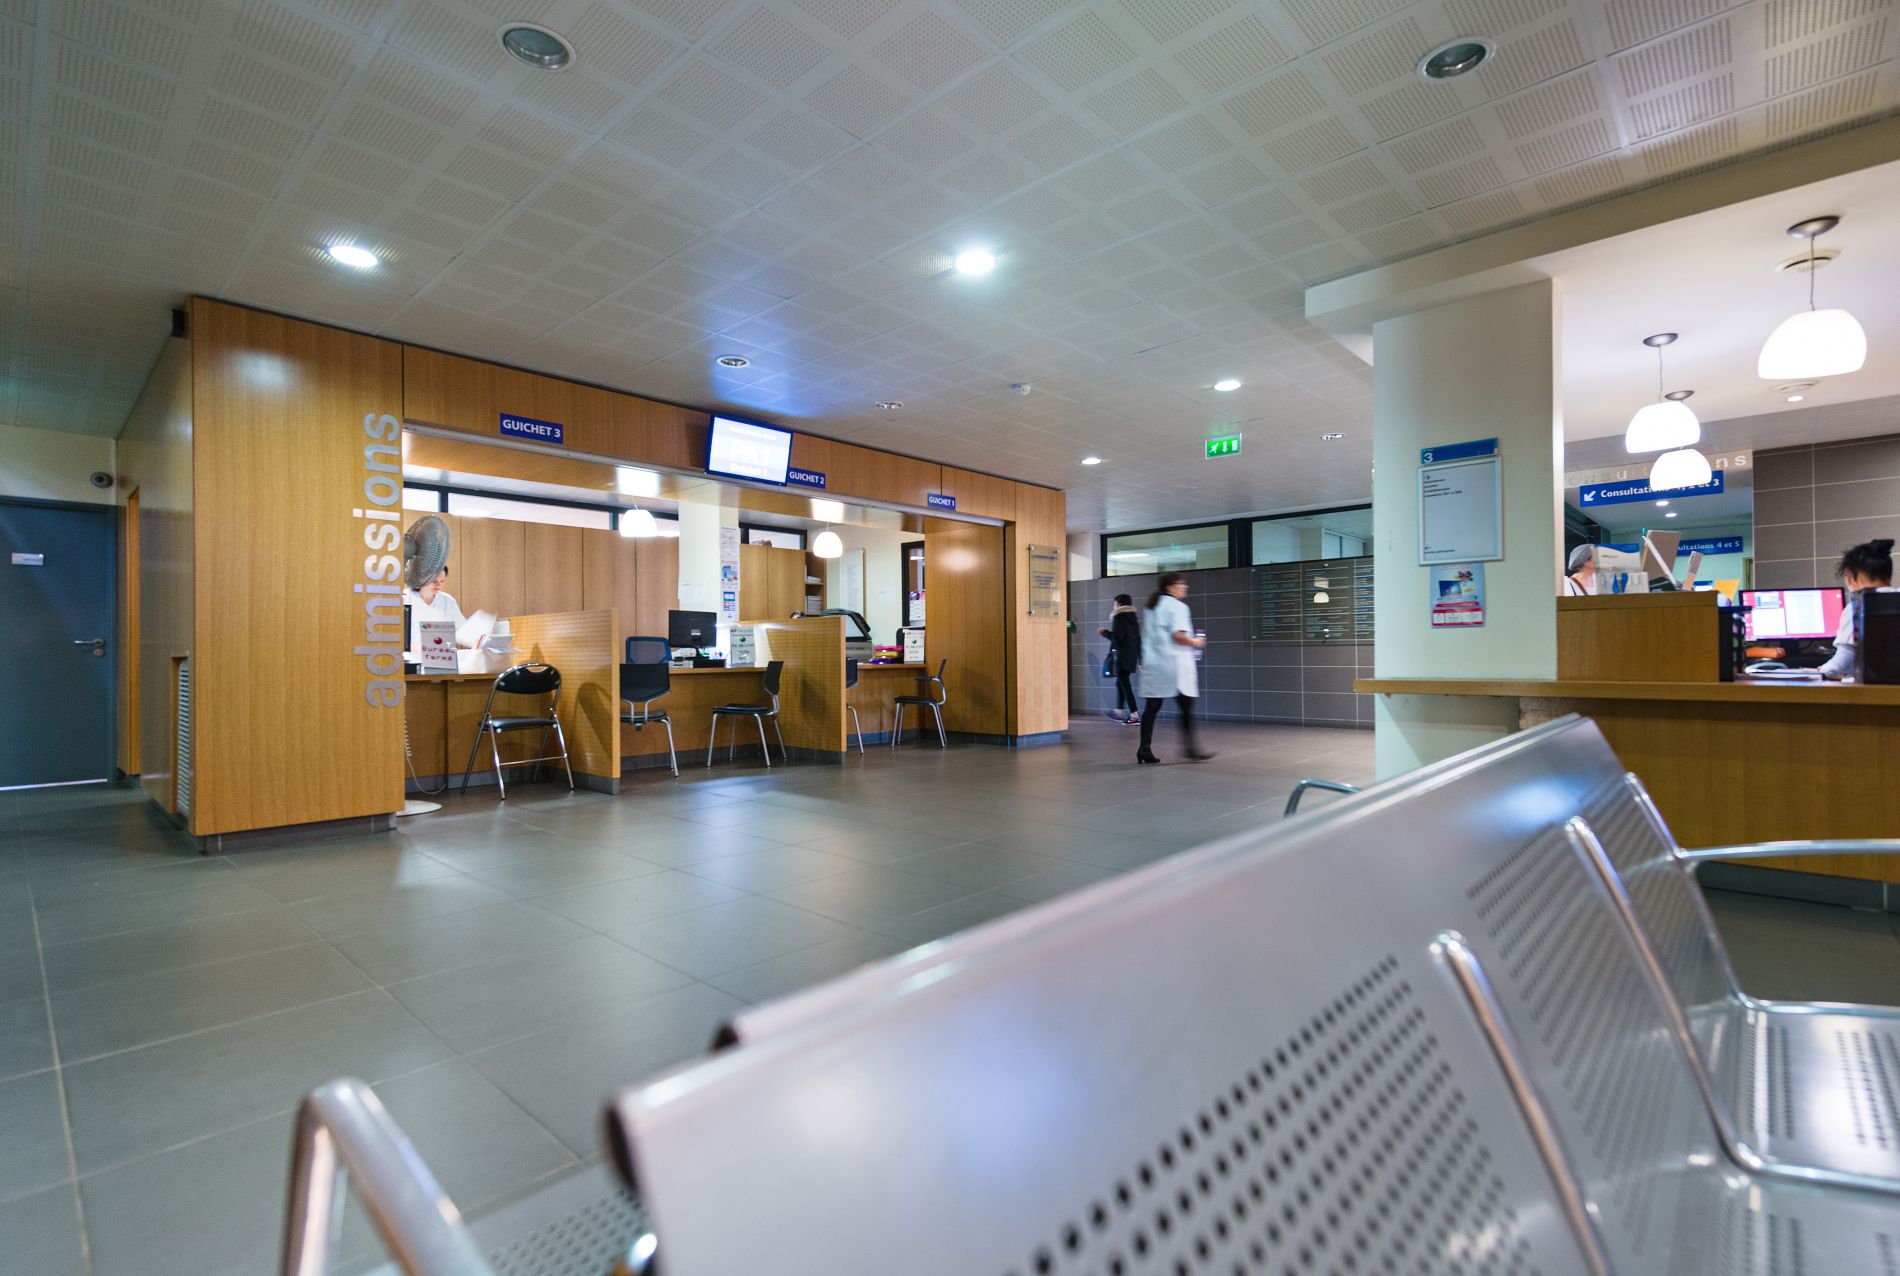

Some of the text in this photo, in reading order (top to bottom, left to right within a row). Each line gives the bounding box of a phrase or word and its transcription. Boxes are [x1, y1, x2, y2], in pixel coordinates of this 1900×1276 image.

[502, 419, 561, 437] GUICHET 3
[1423, 452, 1433, 463] 3
[789, 471, 825, 484] GUICHET 2
[1600, 485, 1671, 497] Consultati
[1713, 478, 1720, 486] 3
[1678, 543, 1714, 551] ultations
[352, 412, 403, 708] admissions
